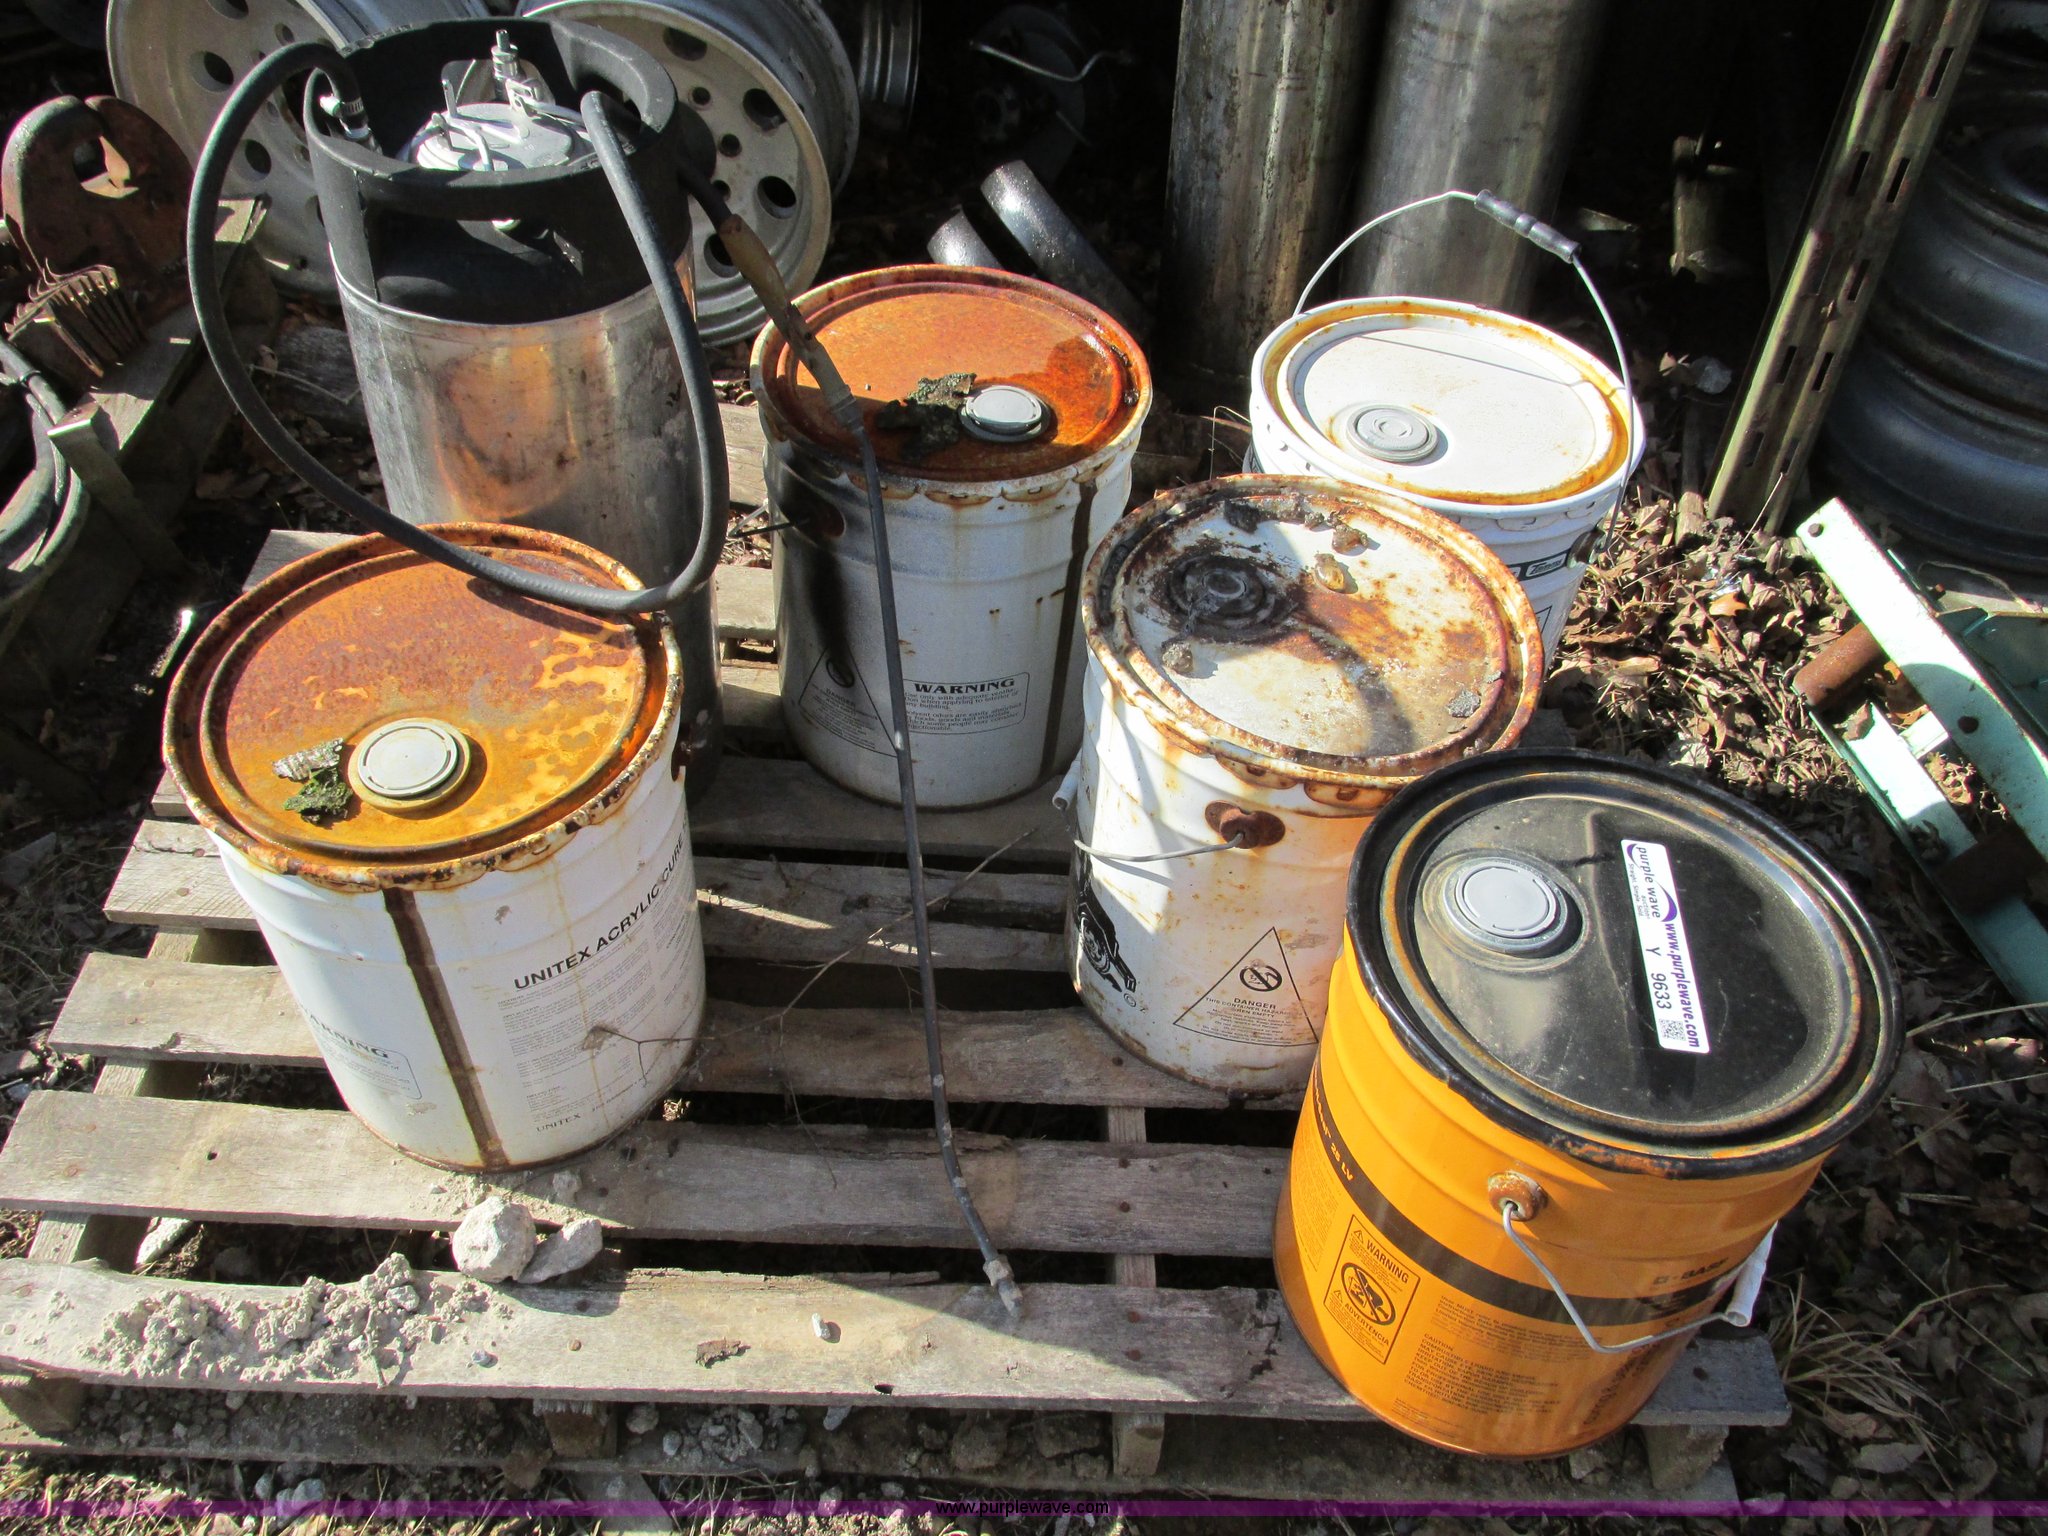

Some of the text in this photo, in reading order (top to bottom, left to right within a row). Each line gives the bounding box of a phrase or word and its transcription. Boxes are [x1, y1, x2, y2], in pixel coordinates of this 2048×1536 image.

[914, 678, 1014, 693] WARNING
[1636, 846, 1661, 918] purple wave
[514, 833, 683, 990] UNITEX ACRYLIC CURE
[1646, 947, 1672, 1010] Y 9633
[1665, 922, 1700, 1048] www.purplewave.com
[1221, 1001, 1260, 1012] CONTAINER
[1234, 997, 1277, 1010] DANGER
[537, 1113, 581, 1132] UNITEX
[1367, 1240, 1409, 1283] WARNING
[1345, 1303, 1389, 1345] ADVERTENCIA
